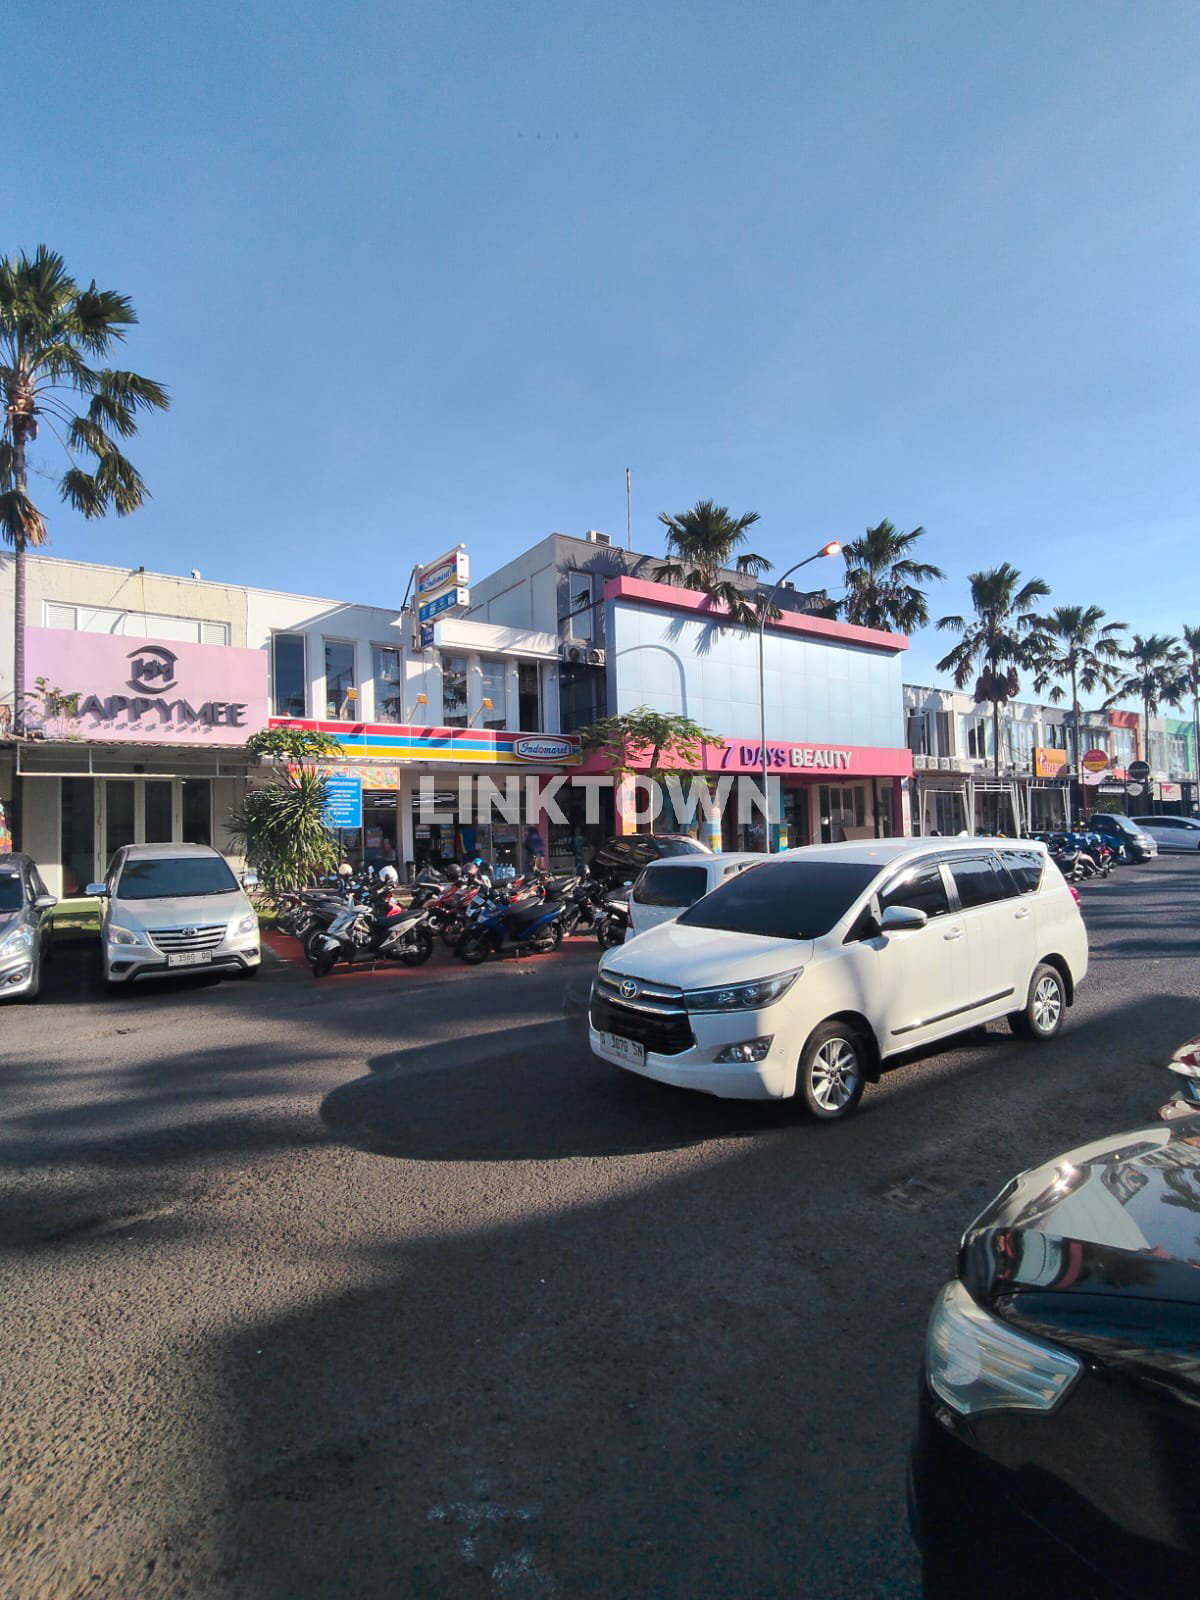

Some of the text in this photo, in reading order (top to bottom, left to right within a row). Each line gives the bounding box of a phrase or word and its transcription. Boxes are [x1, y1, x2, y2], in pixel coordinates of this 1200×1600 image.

[519, 741, 569, 755] Indomaret
[721, 745, 852, 770] 7 DAYS BEAUTY
